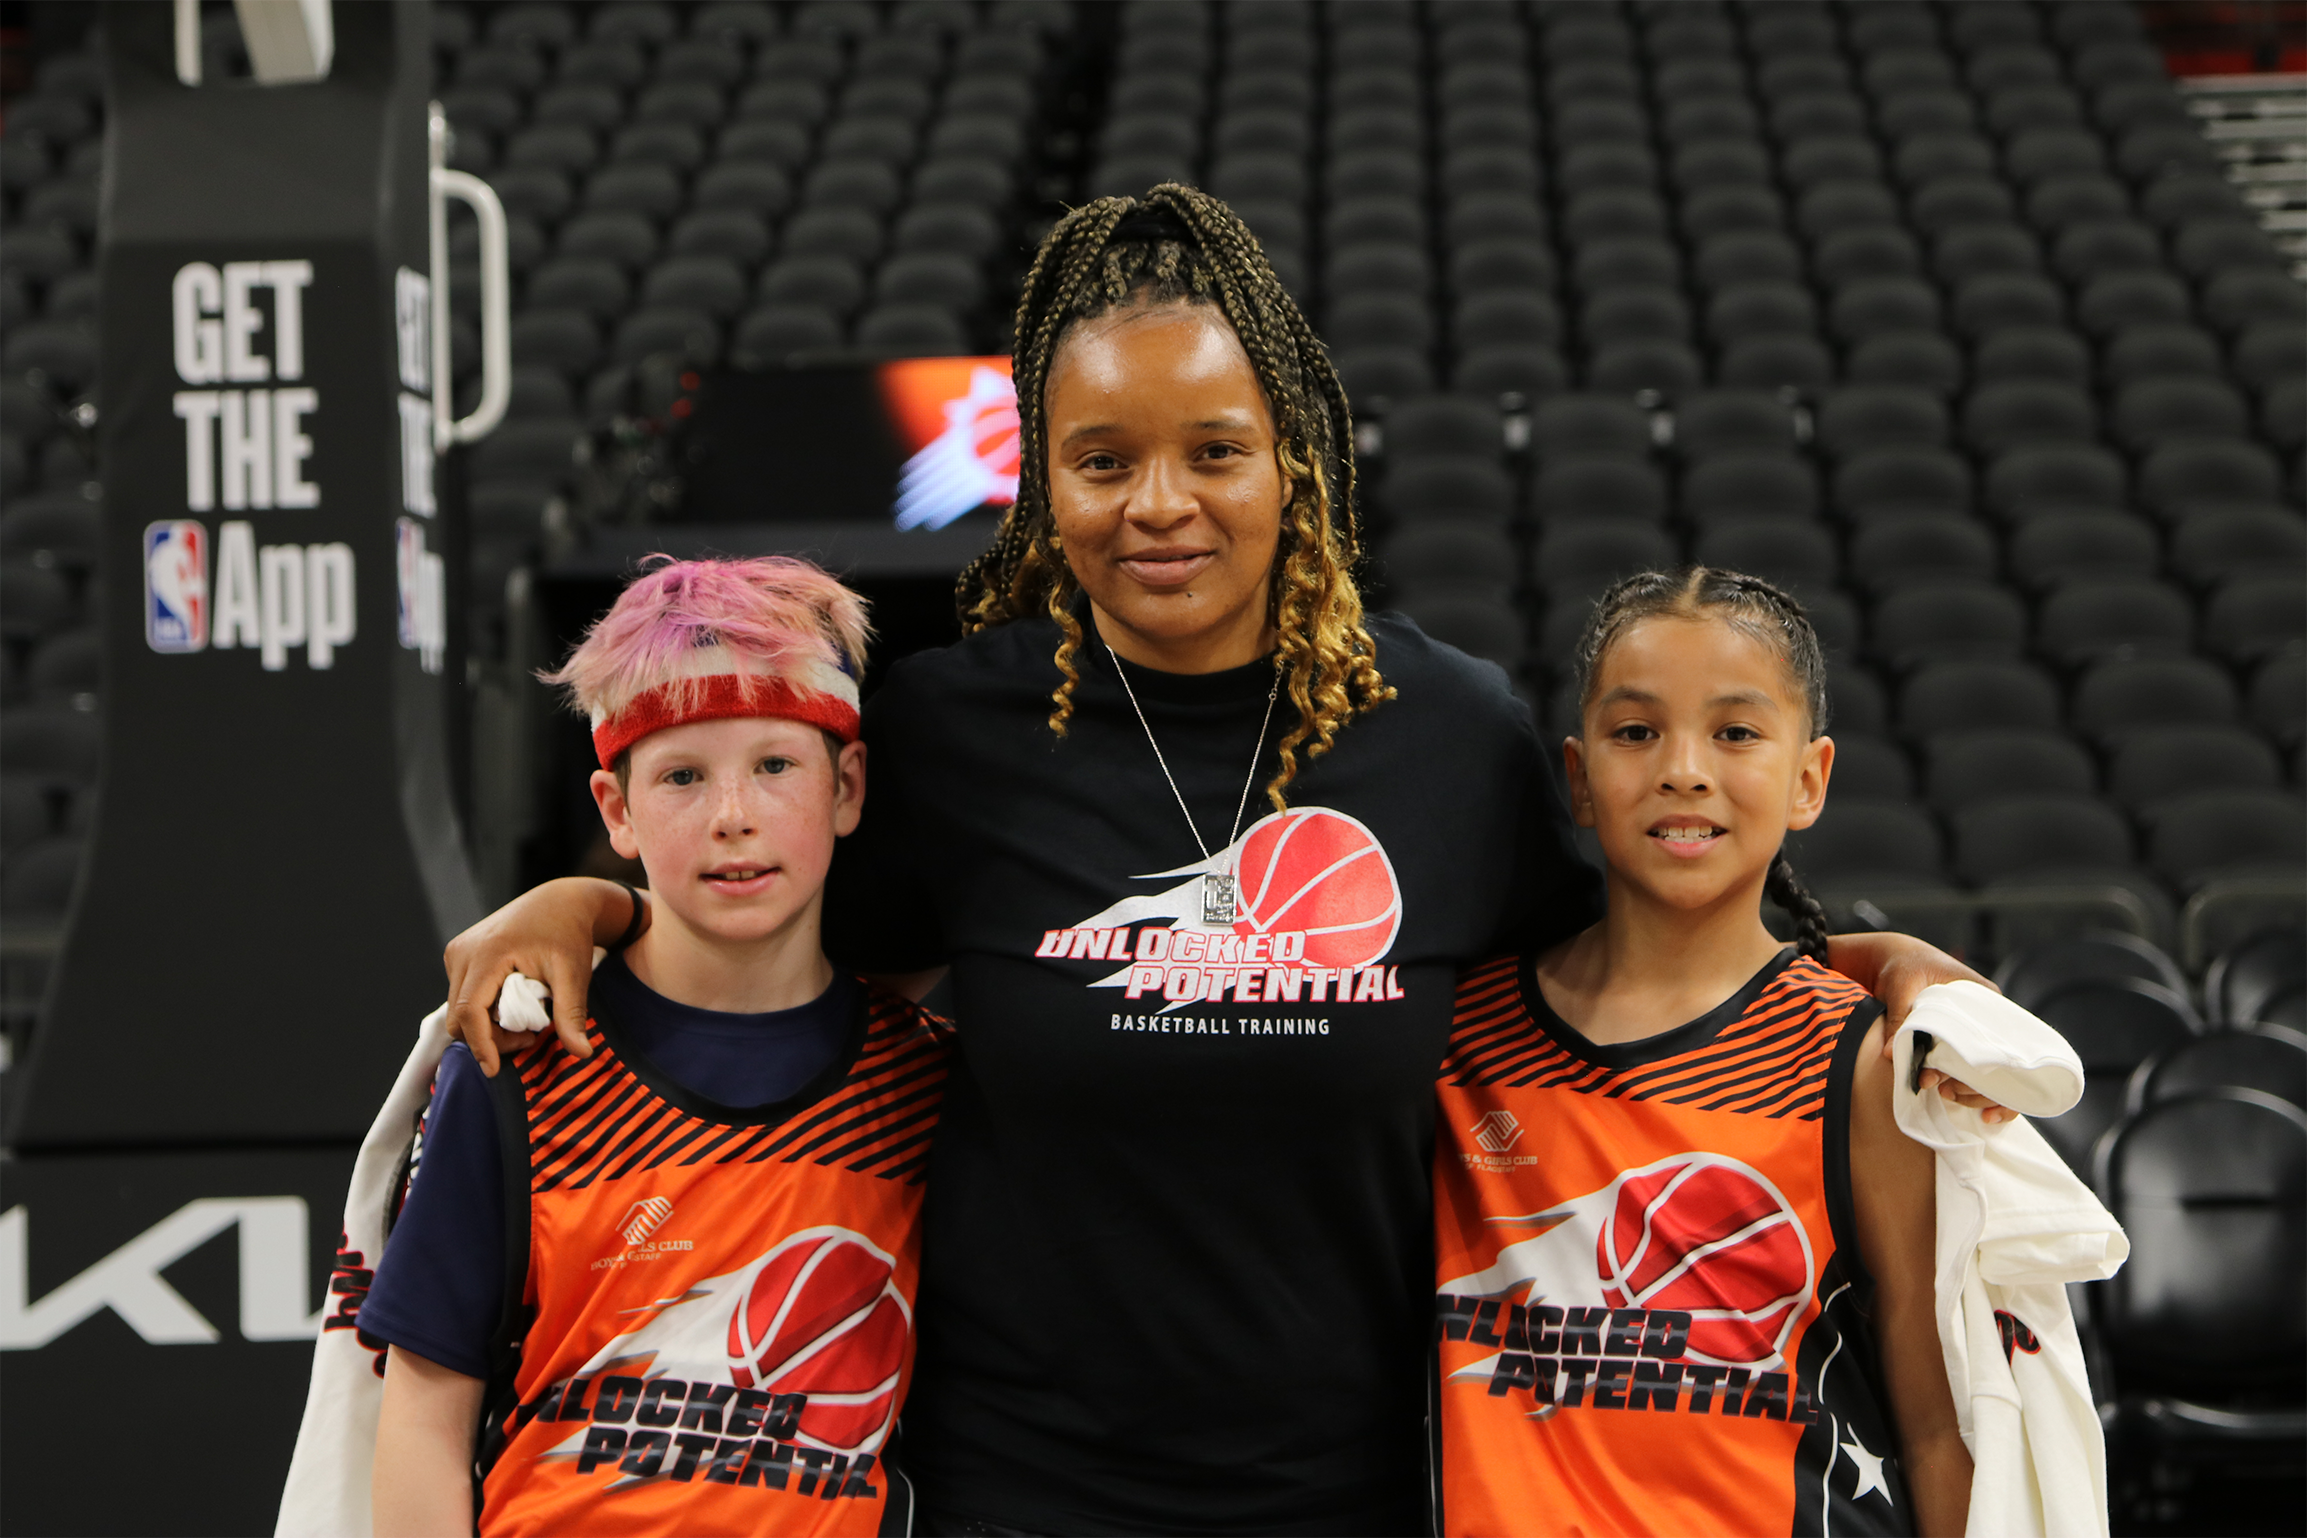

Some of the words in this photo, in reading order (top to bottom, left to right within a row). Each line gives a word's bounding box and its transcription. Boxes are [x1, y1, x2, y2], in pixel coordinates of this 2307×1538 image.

[172, 260, 314, 385] GET
[172, 387, 320, 511] THE
[212, 521, 357, 670] App
[1035, 926, 1306, 964] UNLOCKED
[1124, 964, 1405, 1004] POTENTIAL
[1110, 1013, 1231, 1035] BASKETBALL
[1238, 1018, 1330, 1036] TRAINING
[1513, 1156, 1538, 1165] CLUB
[658, 1240, 694, 1251] CLUB
[1487, 1352, 1819, 1426] POTENTIAL
